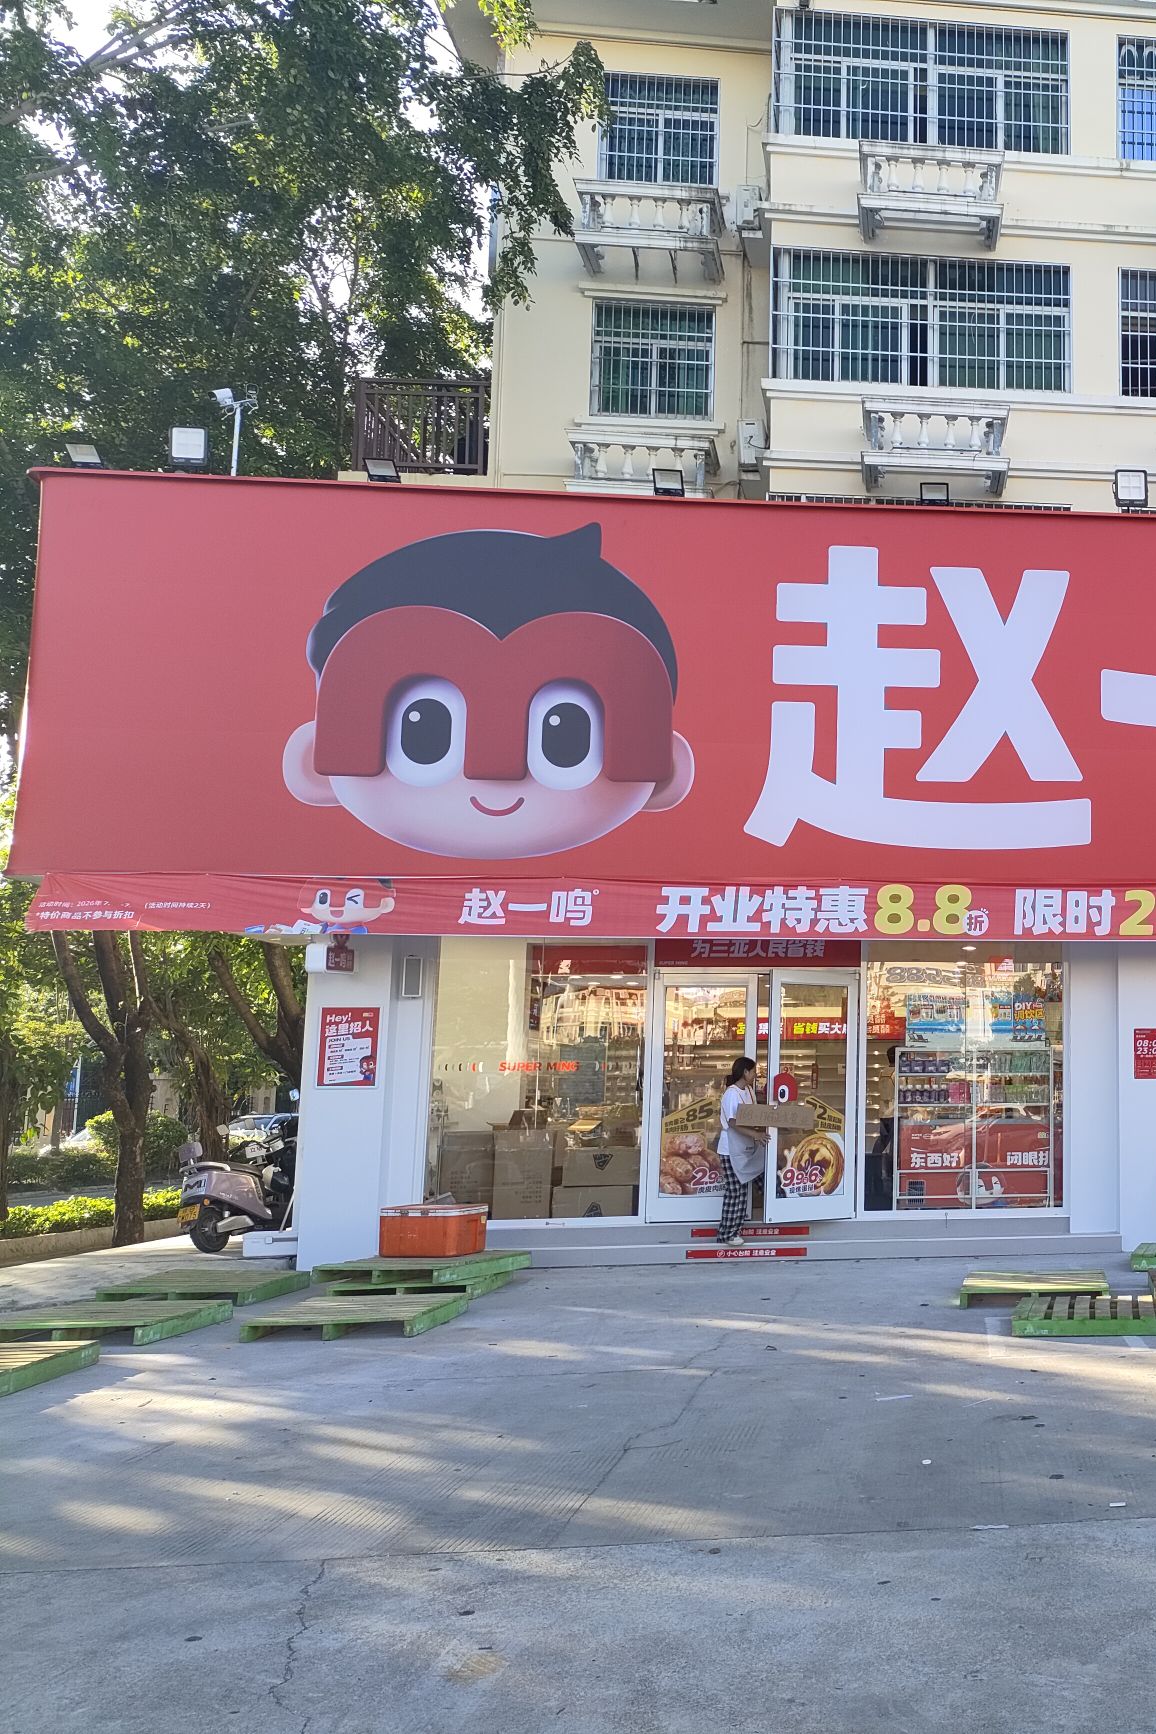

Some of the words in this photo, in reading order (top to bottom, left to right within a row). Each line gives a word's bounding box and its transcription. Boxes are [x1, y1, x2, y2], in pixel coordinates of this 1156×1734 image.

[458, 888, 593, 926] 赵一鸣
[691, 939, 824, 957] 为三亚人民省钱
[326, 1013, 352, 1023] Hey!
[325, 1021, 373, 1036] 这里招人
[498, 1061, 541, 1072] SUPER
[547, 1061, 579, 1072] MING
[911, 1152, 960, 1167] 东西好
